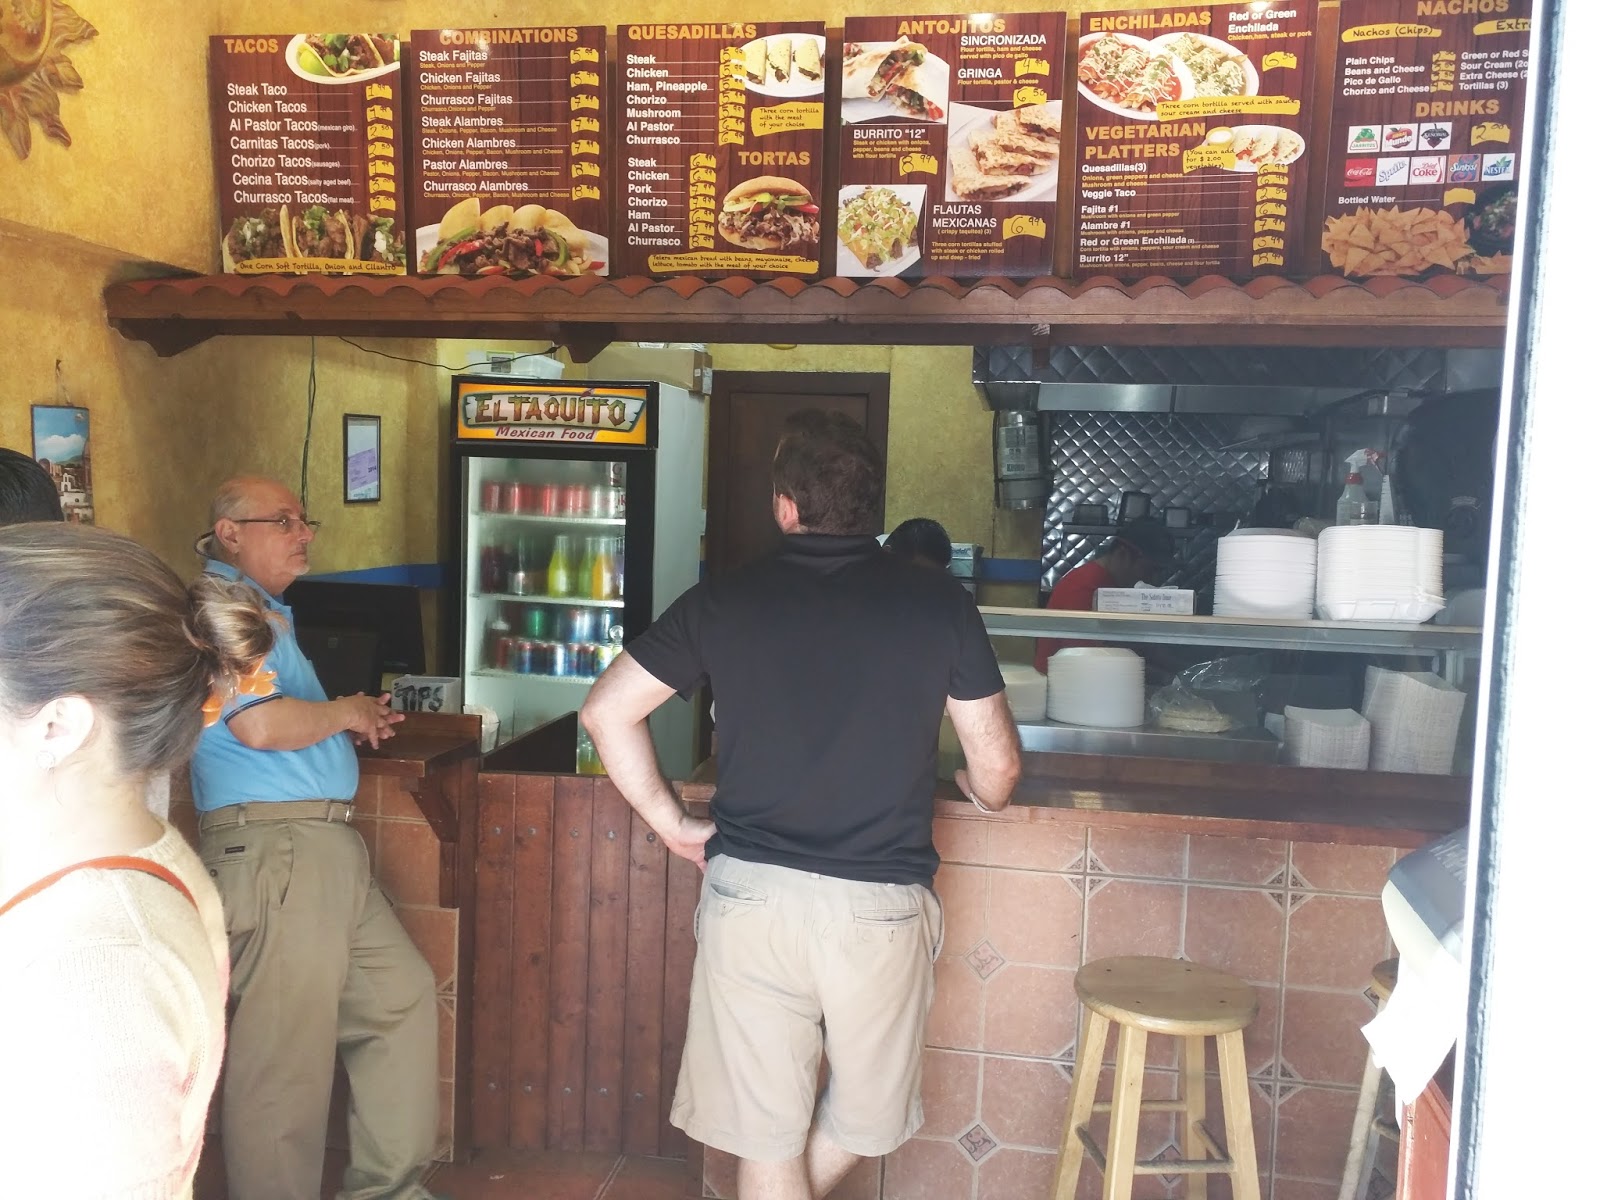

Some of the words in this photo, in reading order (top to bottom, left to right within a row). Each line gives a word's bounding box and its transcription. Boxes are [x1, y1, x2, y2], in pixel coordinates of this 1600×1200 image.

[1417, 0, 1509, 16] NACHOS
[1229, 12, 1249, 21] Red
[1266, 9, 1296, 20] Green
[1090, 11, 1212, 31] ENCHILADAS
[898, 19, 1005, 35] ANTOJITOS
[1228, 23, 1279, 33] Enchilada
[1353, 28, 1390, 37] Nachos
[1395, 25, 1433, 35] (Chips)
[440, 28, 578, 45] COMBINATIONS
[628, 25, 756, 40] QUESADILLAS
[961, 35, 1046, 46] SINCRONIZADA
[224, 39, 278, 53] TACOS
[420, 50, 449, 61] Steak
[453, 50, 487, 62] Fajitas
[627, 55, 656, 64] Steak
[1462, 52, 1488, 60] Green
[1502, 50, 1518, 58] Red
[1346, 57, 1368, 65] Plain
[1370, 56, 1395, 65] Chips
[1461, 62, 1478, 70] Sour
[1481, 61, 1512, 69] Cream
[627, 68, 668, 78] Chicken
[958, 68, 1002, 78] GRINGA
[1392, 65, 1425, 73] Cheese
[420, 73, 462, 83] Chicken
[466, 72, 500, 84] Fajitas
[1379, 76, 1401, 84] Gallo
[1460, 72, 1482, 80] Extra
[227, 83, 258, 95] Steak
[261, 83, 287, 95] Taco
[627, 82, 653, 92] Ham,
[656, 81, 707, 93] Pineapple
[1343, 88, 1376, 96] Chorizo
[1397, 85, 1429, 93] Cheese
[1459, 82, 1494, 90] Tortillas
[1497, 81, 1508, 90] (3)
[421, 94, 474, 105] Churrasco
[478, 94, 512, 106] Fajitas
[627, 95, 667, 104] Chorizo
[228, 101, 272, 112] Chicken
[275, 101, 307, 113] Tacos
[1416, 99, 1499, 117] DRINKS
[627, 109, 681, 117] Mushroom
[230, 119, 240, 131] Al
[245, 119, 281, 131] Pastor
[422, 116, 451, 126] Steak
[454, 116, 503, 126] Alambres
[627, 122, 638, 131] Al
[641, 122, 674, 131] Pastor
[1086, 123, 1205, 140] VEGETARIAN
[627, 135, 680, 144] Churrasco
[854, 130, 902, 139] BURRITO
[231, 137, 278, 149] Carnitas
[422, 138, 464, 148] Chicken
[467, 138, 515, 148] Alambres
[1085, 143, 1179, 160] PLATTERS
[232, 155, 275, 167] Chorizo
[628, 158, 656, 167] Steak
[738, 152, 810, 165] TORTAS
[423, 160, 456, 169] Pastor
[459, 159, 508, 169] Alambres
[628, 171, 669, 180] Chicken
[1413, 169, 1438, 177] Coke
[233, 173, 272, 185] Cecina
[424, 181, 476, 191] Churrasco
[480, 181, 528, 191] Alambres
[628, 184, 651, 193] Pork
[234, 191, 292, 203] Churrasco
[1082, 190, 1112, 199] Veggie
[1115, 189, 1136, 197] Taco
[628, 197, 667, 206] Chorizo
[1339, 196, 1368, 204] Bottled
[1371, 195, 1395, 203] Water
[933, 205, 982, 214] FLAUTAS
[1082, 206, 1106, 215] Fajita
[1108, 205, 1118, 213] #1
[628, 211, 650, 219] Ham
[933, 218, 997, 227] MEXICANAS
[1081, 222, 1118, 231] Alambre
[1120, 221, 1130, 229] #1
[628, 224, 638, 232] Al
[642, 224, 674, 232] Pastor
[628, 237, 680, 246] Churrasco
[1081, 238, 1097, 247] Red
[1112, 238, 1140, 246] Green
[1142, 236, 1187, 244] Enchilada
[1080, 254, 1111, 263] Burrito
[293, 262, 321, 270] Tortilla,
[496, 426, 554, 438] Mexican
[561, 429, 596, 440] Food
[394, 685, 443, 712] TIPS
